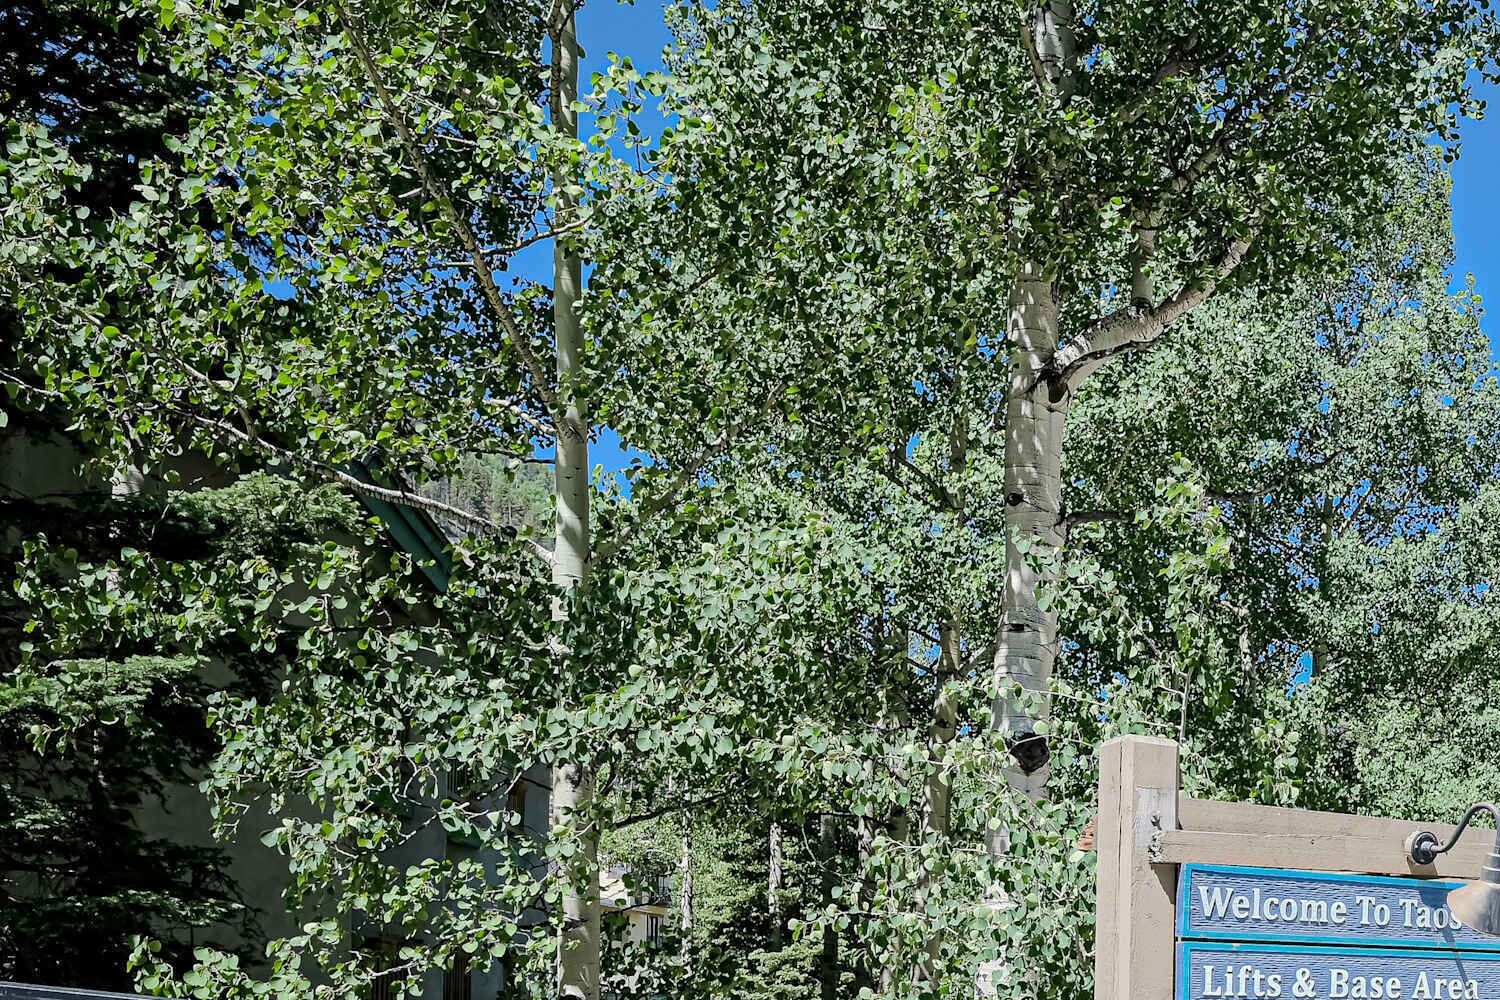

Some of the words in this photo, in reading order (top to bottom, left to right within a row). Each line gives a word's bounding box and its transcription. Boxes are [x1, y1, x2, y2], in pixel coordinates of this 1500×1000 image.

[1198, 886, 1346, 924] Welcome
[1357, 896, 1390, 927] To
[1400, 899, 1462, 930] Taos
[1201, 965, 1281, 998] Lifts
[1292, 967, 1316, 998] &
[1329, 967, 1401, 1000] Base
[1412, 971, 1479, 1000] Area
